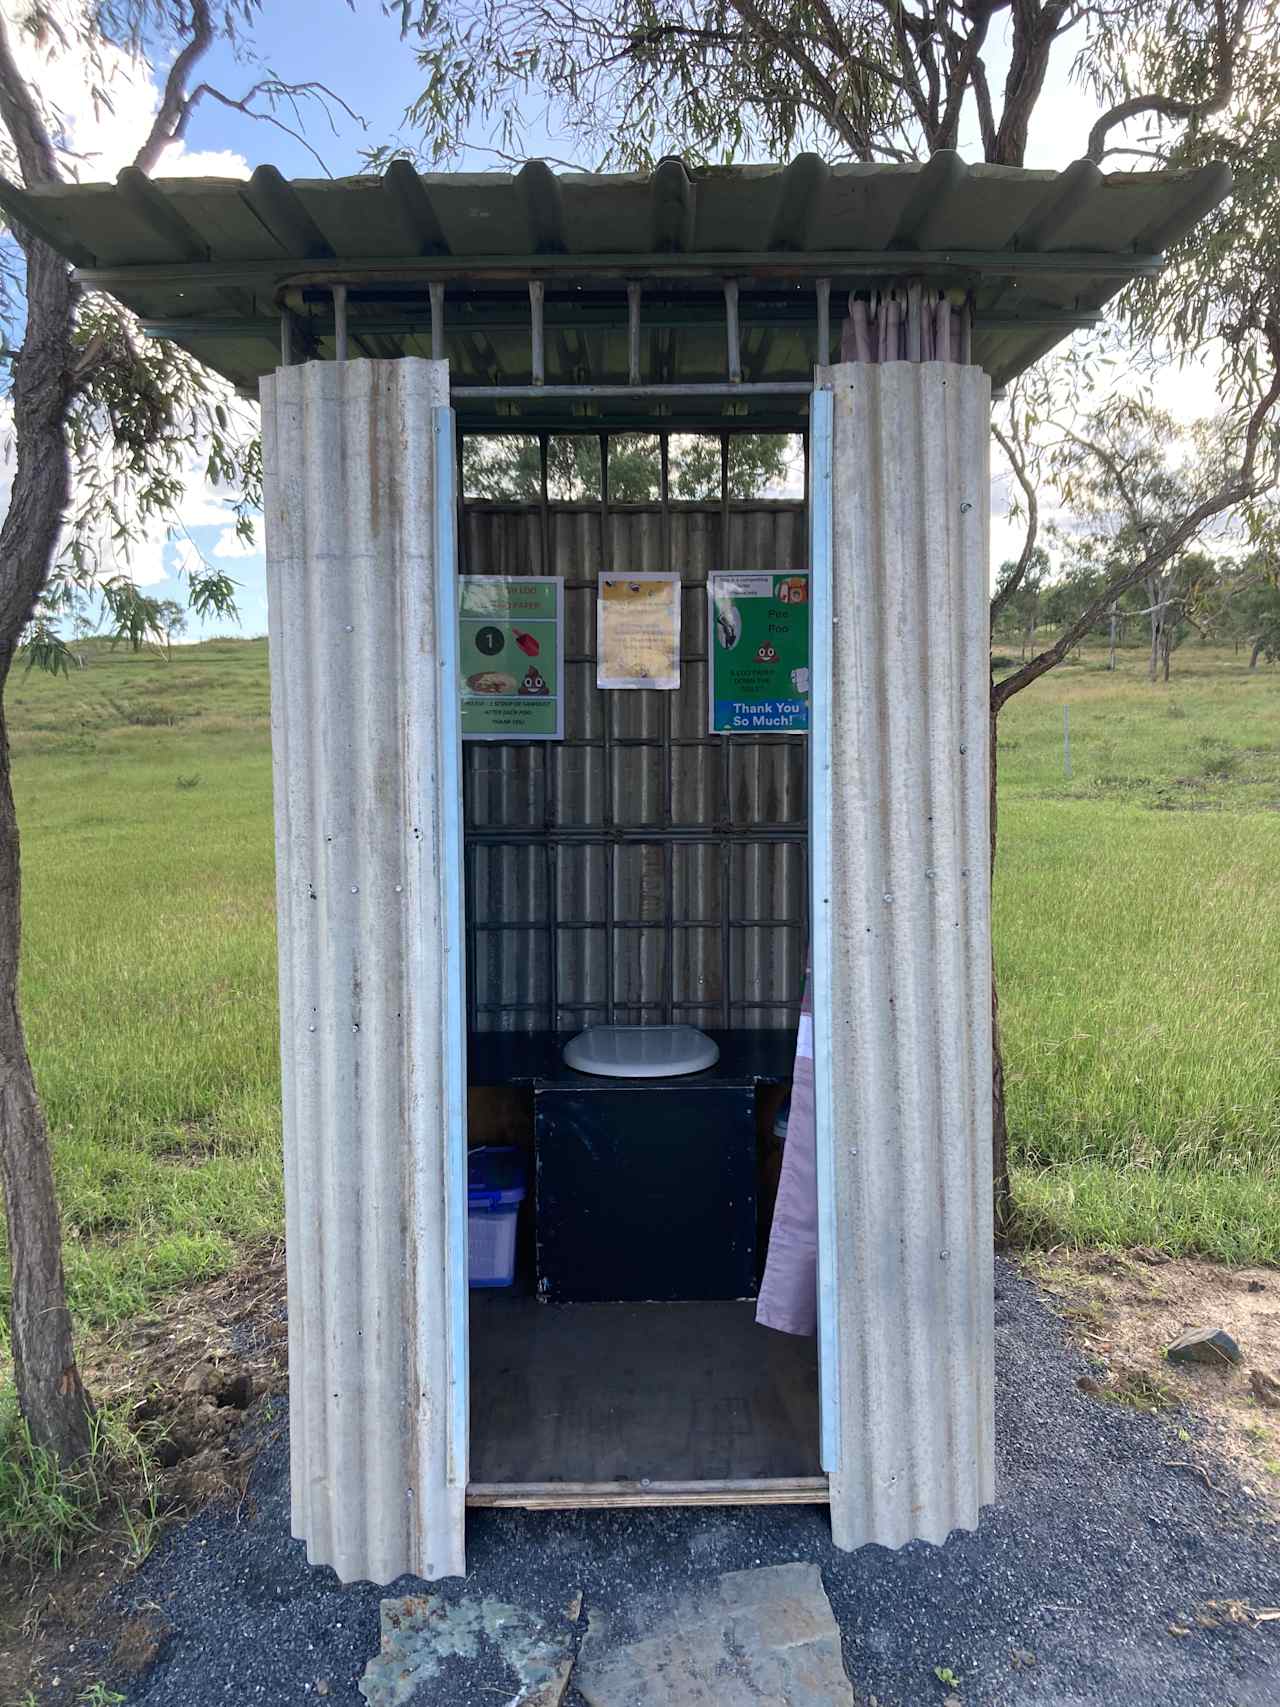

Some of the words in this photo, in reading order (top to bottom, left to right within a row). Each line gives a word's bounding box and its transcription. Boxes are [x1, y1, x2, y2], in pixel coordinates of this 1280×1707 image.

[768, 623, 789, 633] Poo
[486, 634, 492, 649] 1
[733, 703, 772, 713] Thank
[776, 702, 800, 713] You
[733, 716, 749, 726] So
[752, 715, 793, 726] Much!
